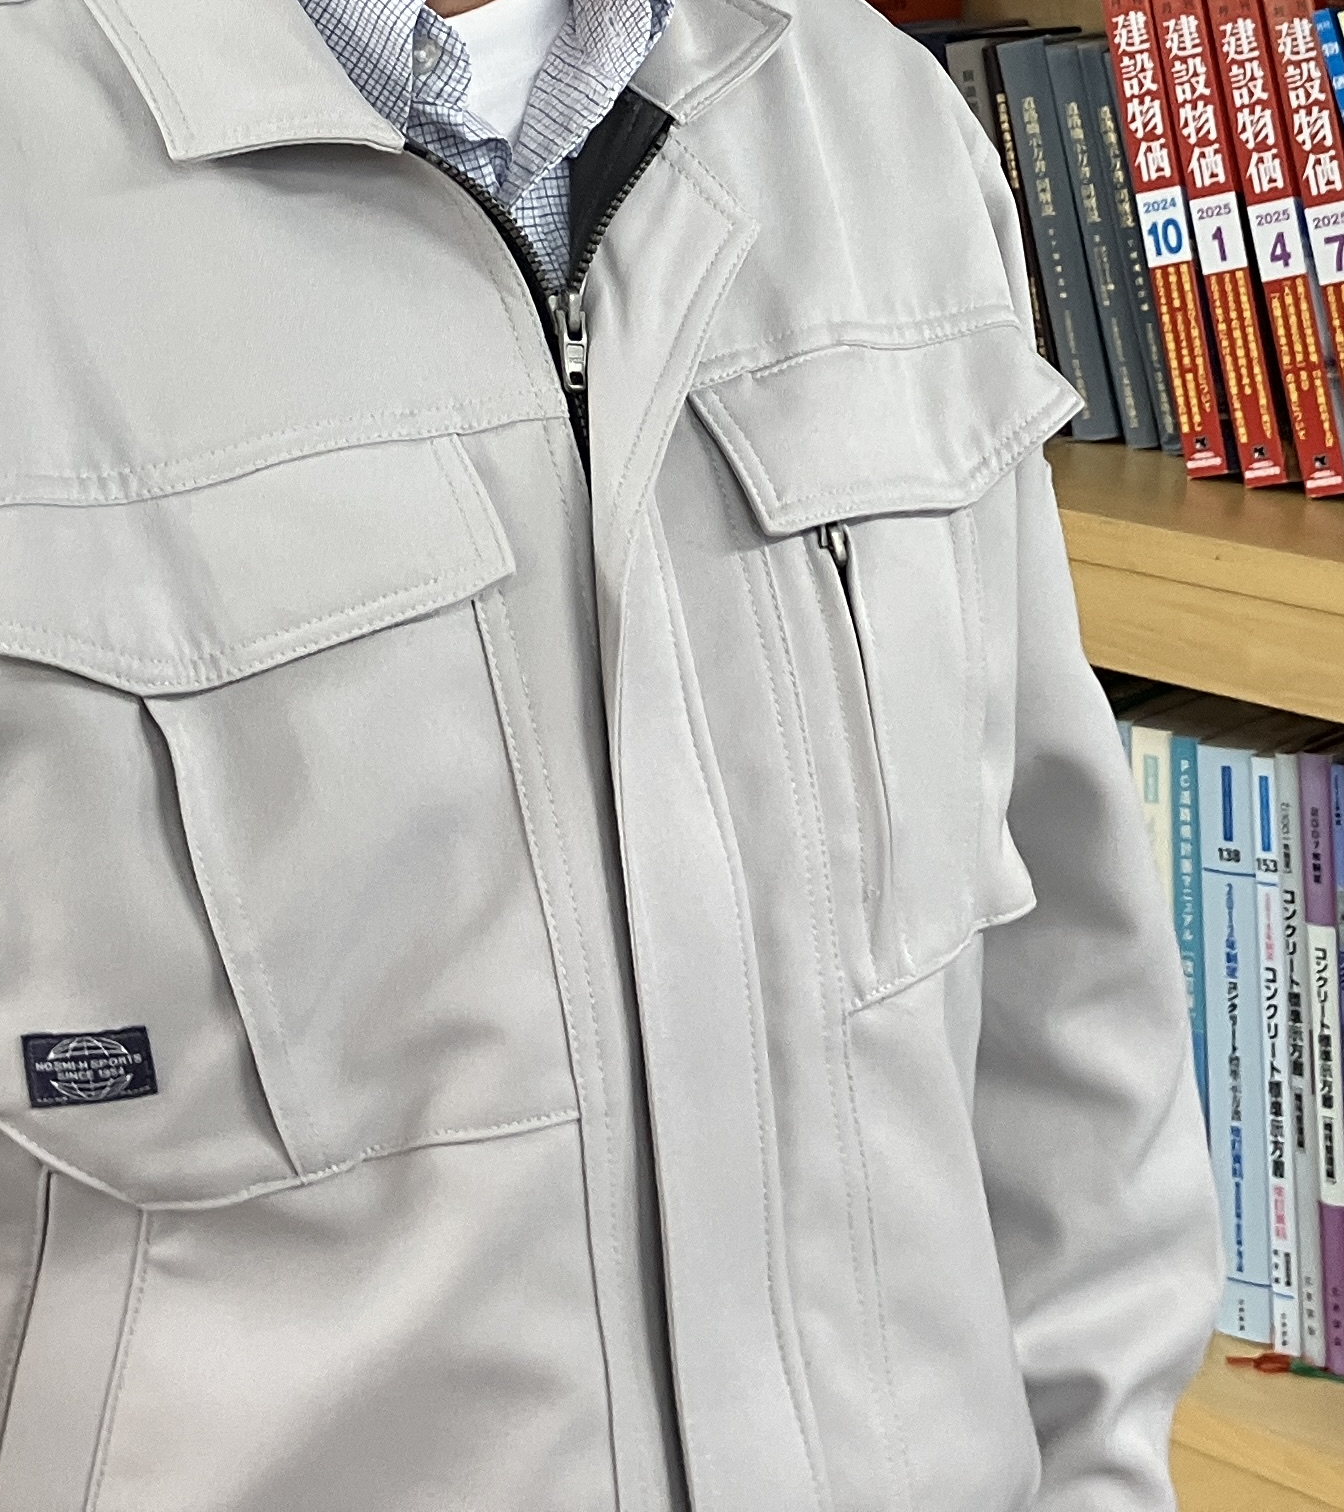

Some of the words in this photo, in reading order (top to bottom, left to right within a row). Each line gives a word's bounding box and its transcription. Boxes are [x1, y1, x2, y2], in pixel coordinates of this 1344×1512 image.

[1111, 10, 1172, 183] 建設物価
[1162, 14, 1226, 188] 建設物価
[1218, 17, 1285, 194] 建設物価
[1274, 17, 1343, 196] 建設物価
[1143, 197, 1177, 214] 2024
[1196, 203, 1232, 220] 2025
[1255, 208, 1290, 227] 2025
[1147, 218, 1183, 256] 10
[1211, 226, 1228, 263] 1
[1269, 231, 1292, 268] 4
[1218, 848, 1241, 863] 138
[1256, 858, 1278, 873] 153
[1283, 889, 1304, 1077] コンクリート標準示方書
[1314, 946, 1335, 1110] コンクリート標準示方書
[1264, 966, 1285, 1179] コンクリート標準示方書
